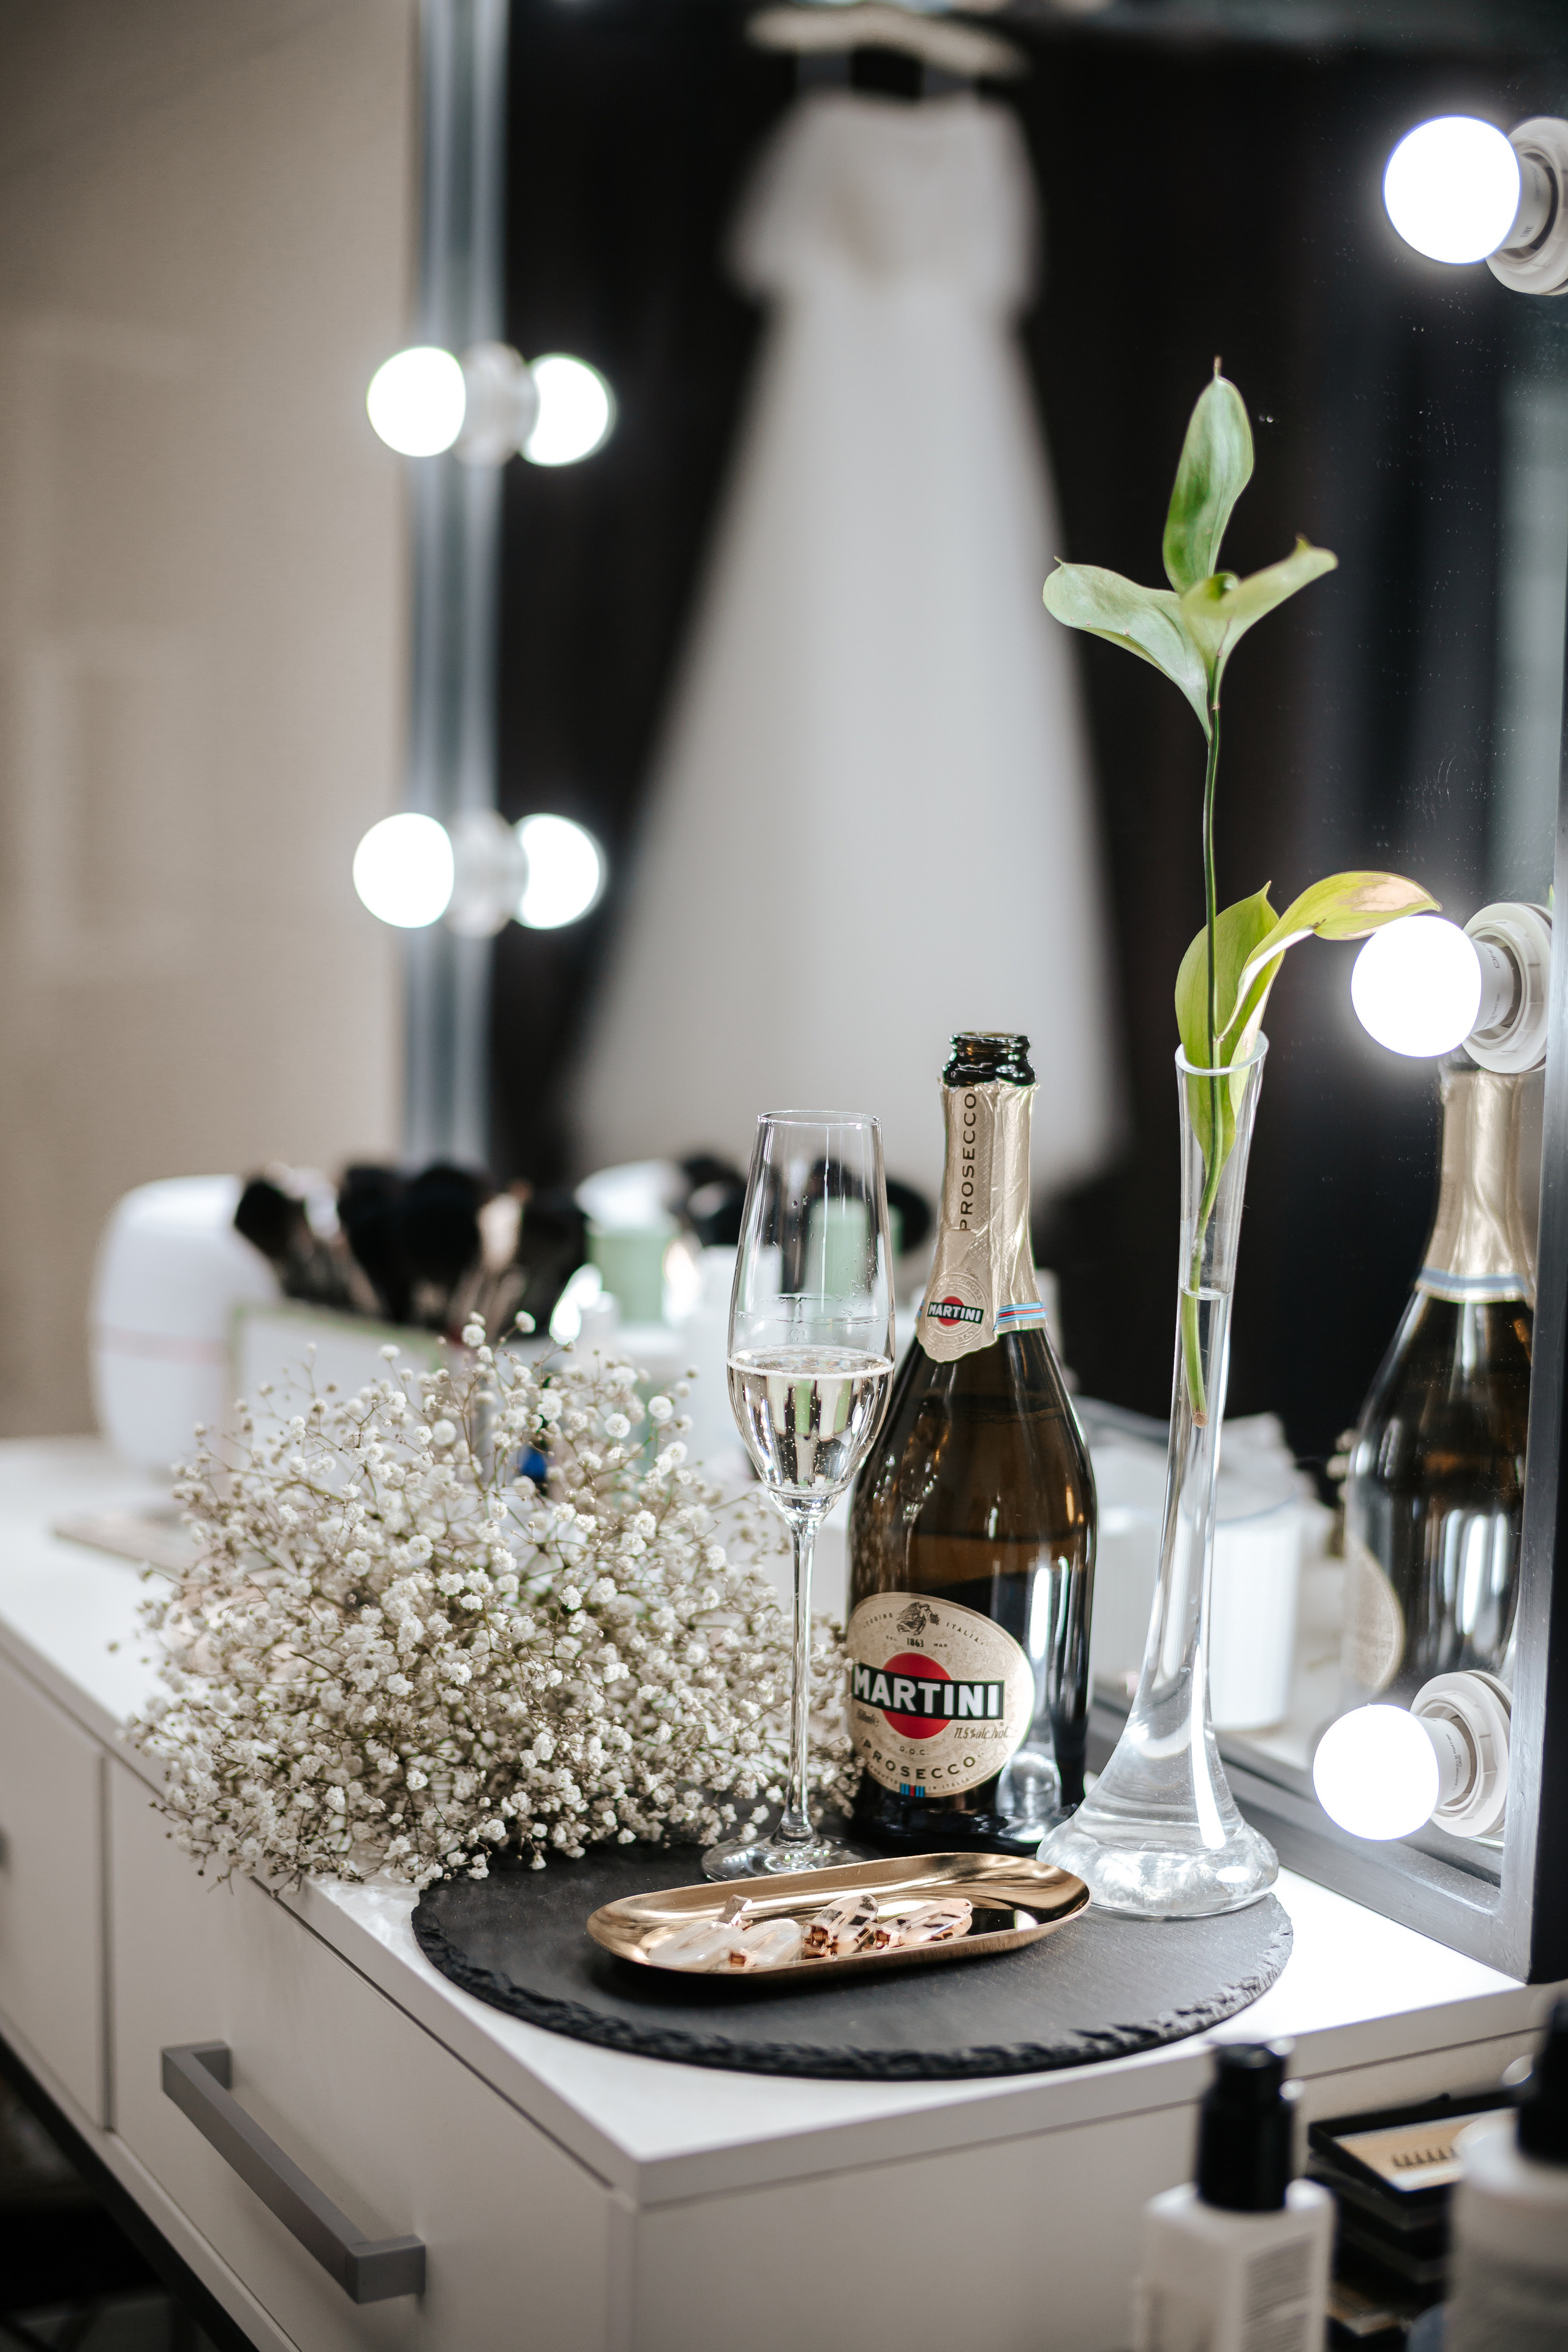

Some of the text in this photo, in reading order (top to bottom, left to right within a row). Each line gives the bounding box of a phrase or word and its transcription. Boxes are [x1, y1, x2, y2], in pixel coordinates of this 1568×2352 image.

[959, 1093, 977, 1231] PROSECCO
[928, 1304, 981, 1322] MARTINI
[907, 1637, 924, 1648] 1863
[854, 1664, 1000, 1717] MARTINI
